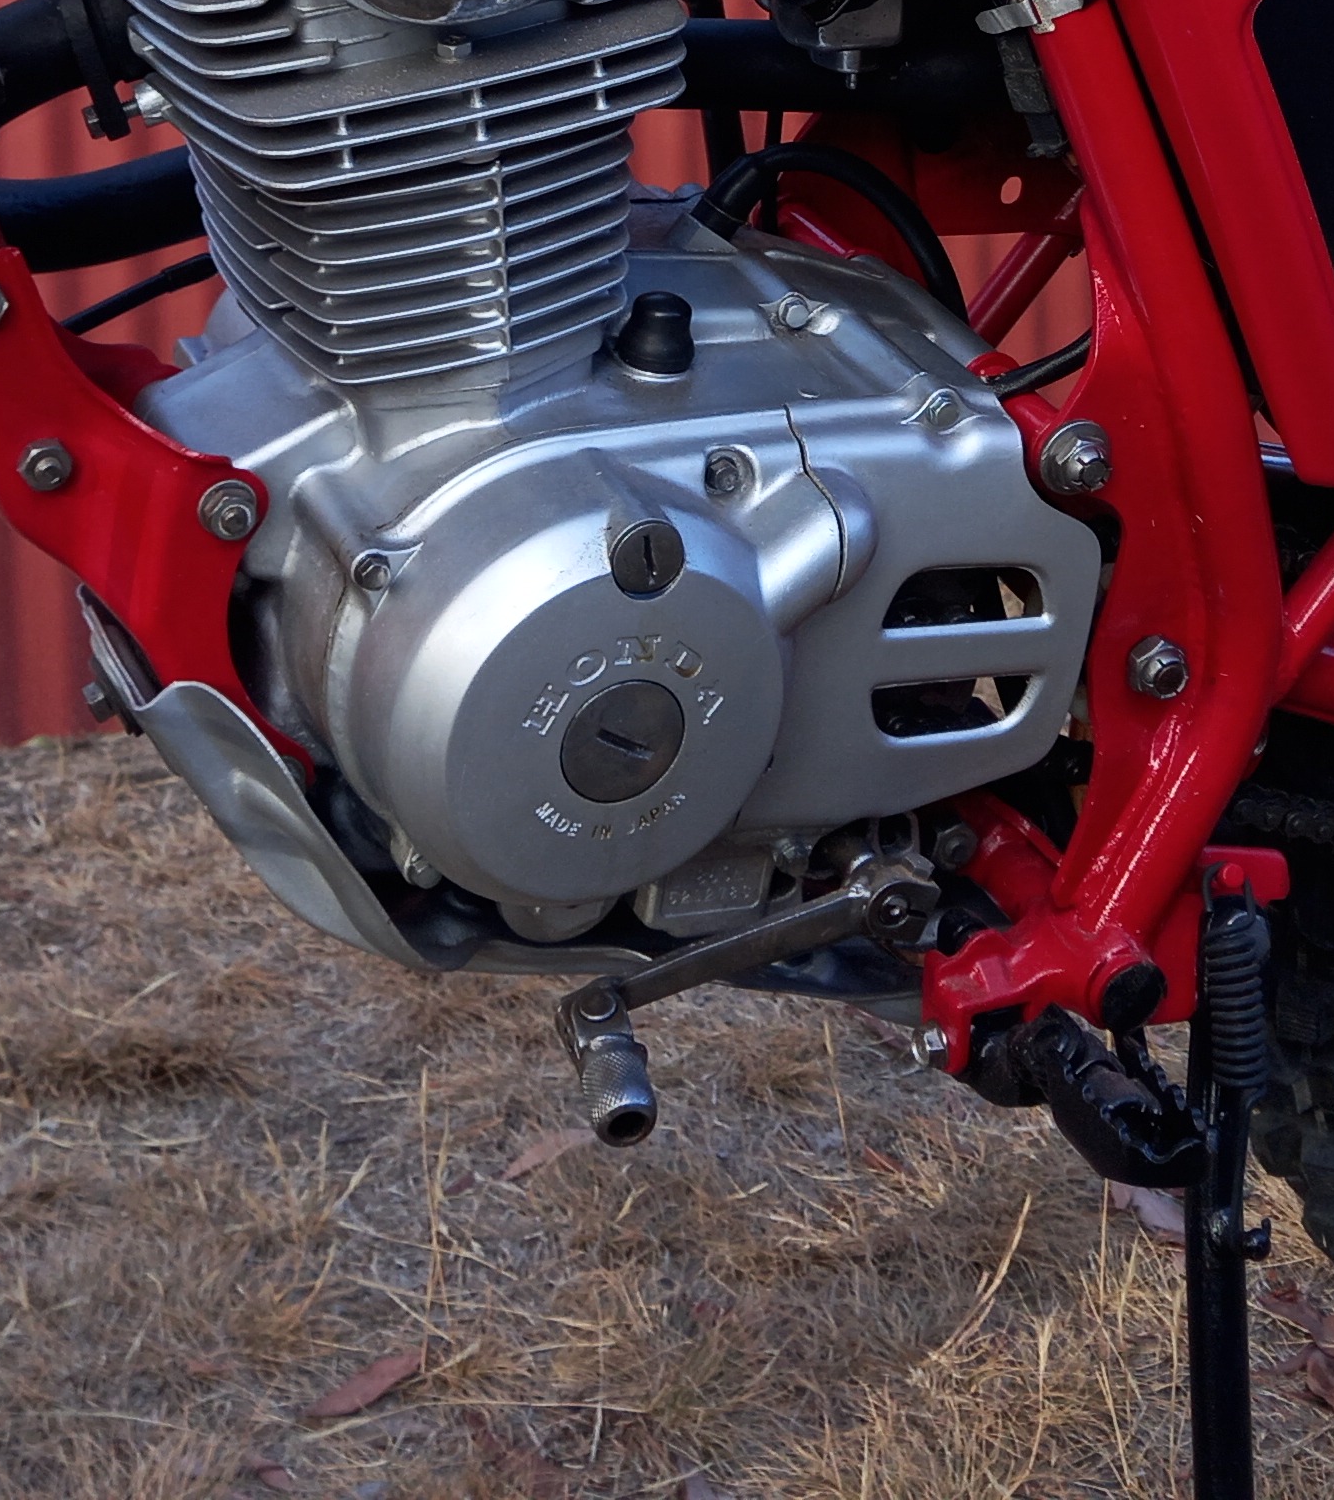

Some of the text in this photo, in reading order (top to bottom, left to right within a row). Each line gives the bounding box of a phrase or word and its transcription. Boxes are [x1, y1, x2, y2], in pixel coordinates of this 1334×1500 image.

[522, 633, 723, 735] HONDA
[535, 792, 686, 841] MADE IN JAPAN
